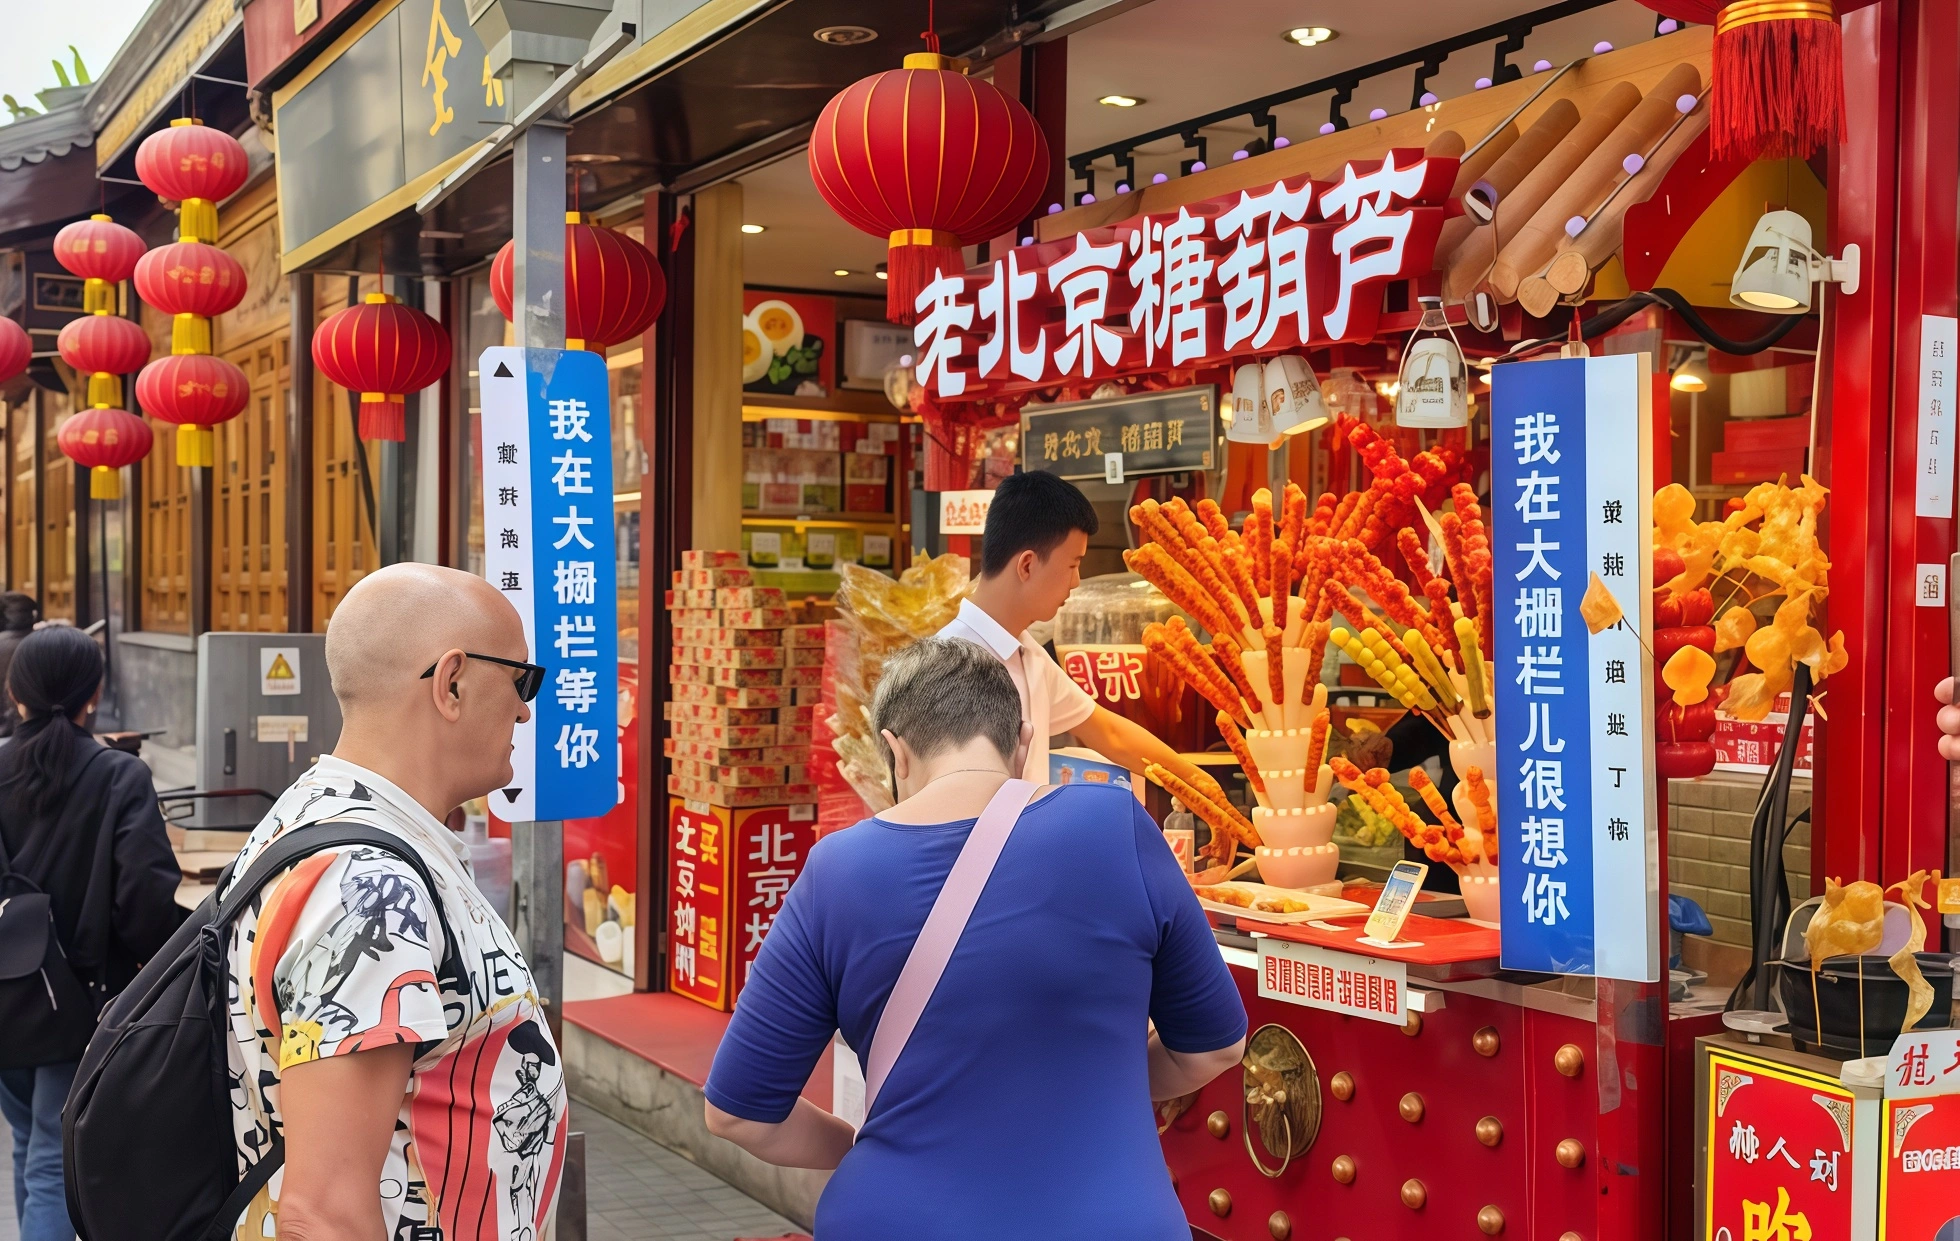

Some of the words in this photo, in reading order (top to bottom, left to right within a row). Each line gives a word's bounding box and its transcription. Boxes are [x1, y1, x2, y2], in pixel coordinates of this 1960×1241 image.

[914, 150, 1428, 398] 老北京糖葫芦
[1513, 412, 1571, 926] 我在大栅栏儿很想你
